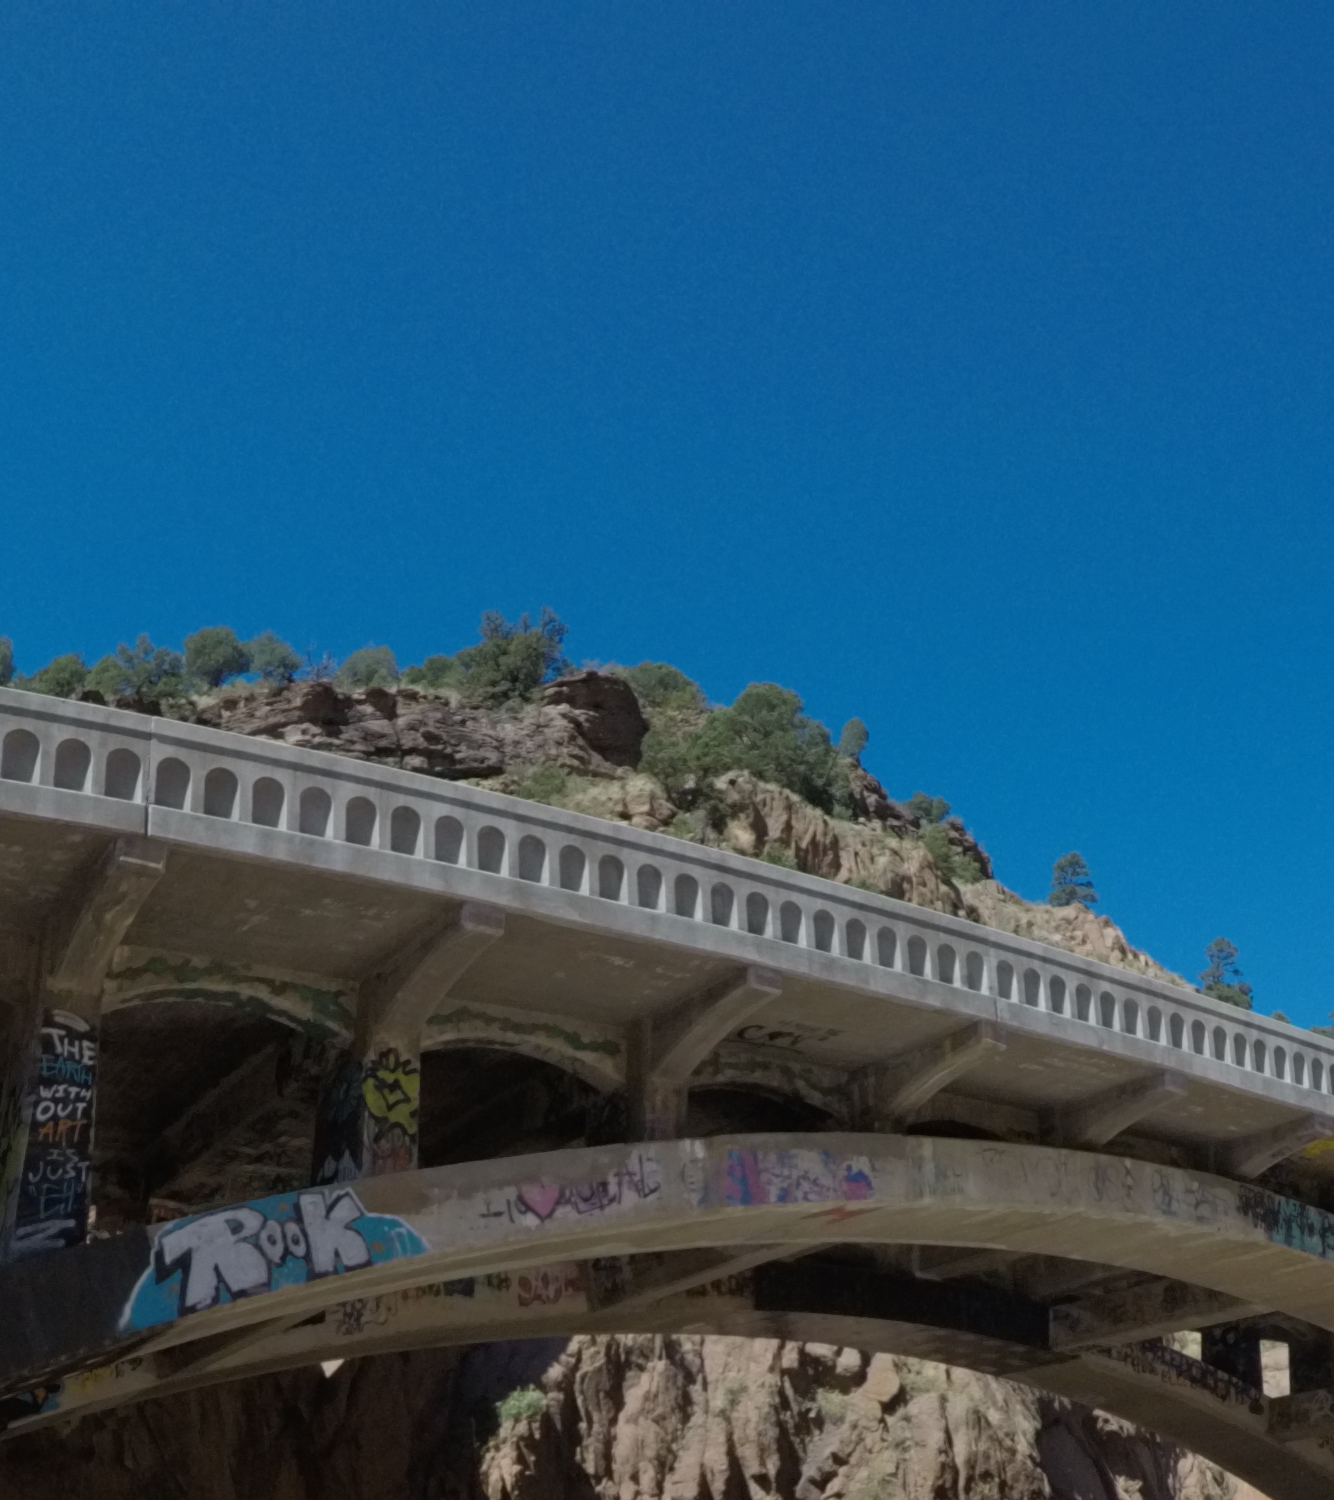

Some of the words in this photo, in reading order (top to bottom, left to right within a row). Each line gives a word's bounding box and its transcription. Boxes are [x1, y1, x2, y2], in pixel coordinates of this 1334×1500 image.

[41, 1027, 95, 1065] THE
[40, 1053, 92, 1085] EARTH
[39, 1083, 91, 1101] WITH
[35, 1101, 87, 1121] OUT
[38, 1119, 87, 1144] ART
[46, 1149, 79, 1164] IS
[28, 1160, 90, 1183] JUST
